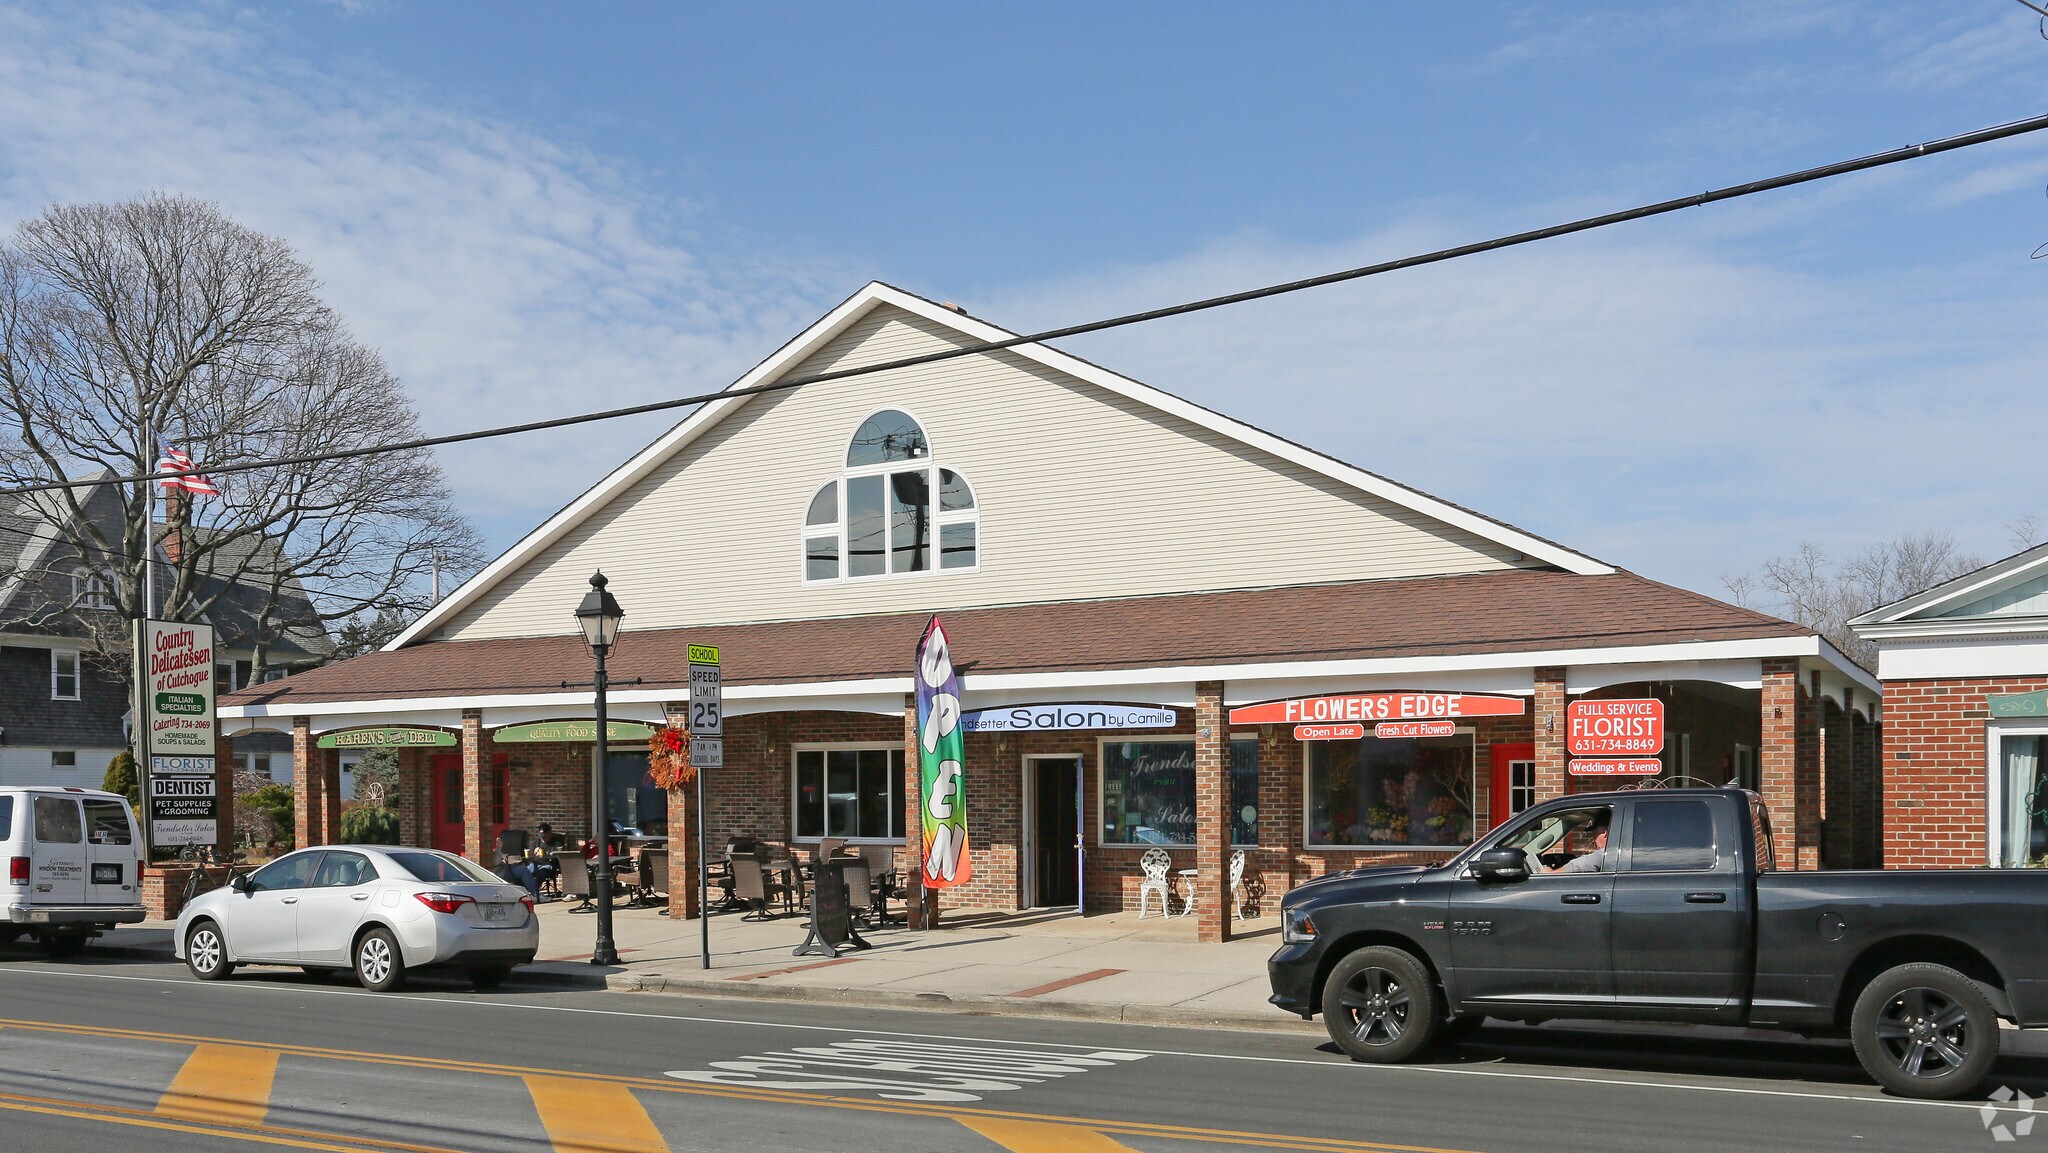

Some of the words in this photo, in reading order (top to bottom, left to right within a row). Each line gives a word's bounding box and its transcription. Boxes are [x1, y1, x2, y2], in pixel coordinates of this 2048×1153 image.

[156, 627, 194, 652] Country
[691, 648, 717, 661] SCHOOL
[151, 648, 211, 676] Delicatessen
[157, 675, 165, 691] of
[167, 669, 209, 689] Cutchogue
[692, 671, 719, 683] SPEED
[694, 686, 716, 697] LIMIT
[168, 696, 194, 704] ITALIAN
[161, 703, 202, 712] SPECIALTIES
[1285, 696, 1393, 722] FLOWERS'
[1400, 695, 1462, 717] EDGE
[1578, 704, 1604, 716] FULL
[1607, 703, 1653, 715] SERVICE
[693, 702, 719, 728] 25
[961, 718, 1007, 729] ndsetter
[1009, 708, 1107, 729] Salon
[1108, 714, 1124, 727] by
[1127, 711, 1173, 725] Camille
[154, 716, 180, 731] Catering
[181, 720, 211, 729] 734-2069
[1378, 725, 1400, 736] Fresh
[1402, 724, 1418, 735] Cut
[1420, 724, 1452, 735] Flowers
[1573, 717, 1658, 737] FLORIST
[336, 731, 384, 745] KAREN'S
[408, 730, 436, 744] DELI
[529, 728, 561, 739] QUALITY
[566, 728, 588, 738] FOOD
[592, 727, 617, 737] SRE
[1302, 727, 1330, 738] Open
[1334, 726, 1355, 737] Late
[1575, 738, 1655, 751] 631-734-8849
[921, 625, 966, 882] OPEN
[153, 757, 214, 769] FLORIST
[1130, 751, 1197, 777] Trendse
[1572, 761, 1615, 774] Weddings
[1617, 762, 1626, 772] &
[1629, 761, 1659, 772] Events
[155, 780, 211, 795] DENTIST
[173, 800, 212, 808] SUPPLIES
[194, 822, 215, 832] Salon
[1453, 928, 1491, 936] 1500
